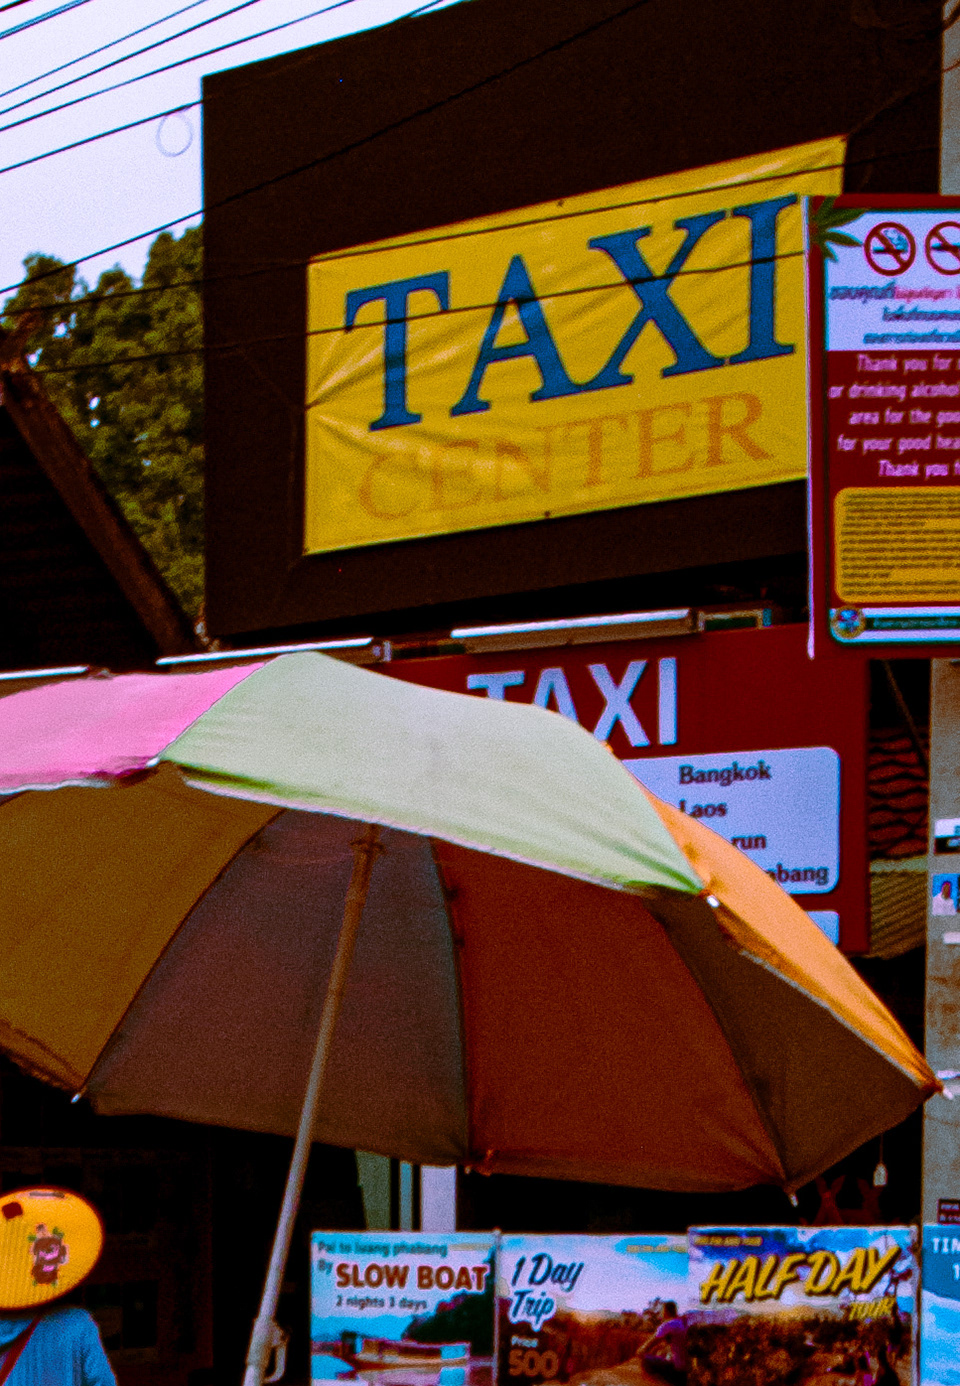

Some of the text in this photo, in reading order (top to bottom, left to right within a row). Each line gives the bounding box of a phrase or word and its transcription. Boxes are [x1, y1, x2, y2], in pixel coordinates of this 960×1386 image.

[344, 193, 798, 432] TAXI
[857, 354, 898, 372] Thank
[358, 391, 774, 521] CENTER
[878, 459, 920, 477] Thank
[467, 658, 677, 747] TAXI
[679, 759, 772, 786] Bangkok
[679, 799, 727, 818] Laos
[932, 1237, 960, 1254] TIM
[336, 1263, 489, 1291] SLOW BOAT
[512, 1253, 584, 1292] 1 Day
[700, 1245, 901, 1304] HALF DAY
[346, 1296, 385, 1310] nights
[400, 1297, 427, 1311] days
[511, 1289, 554, 1324] Trip
[508, 1349, 559, 1378] 500
